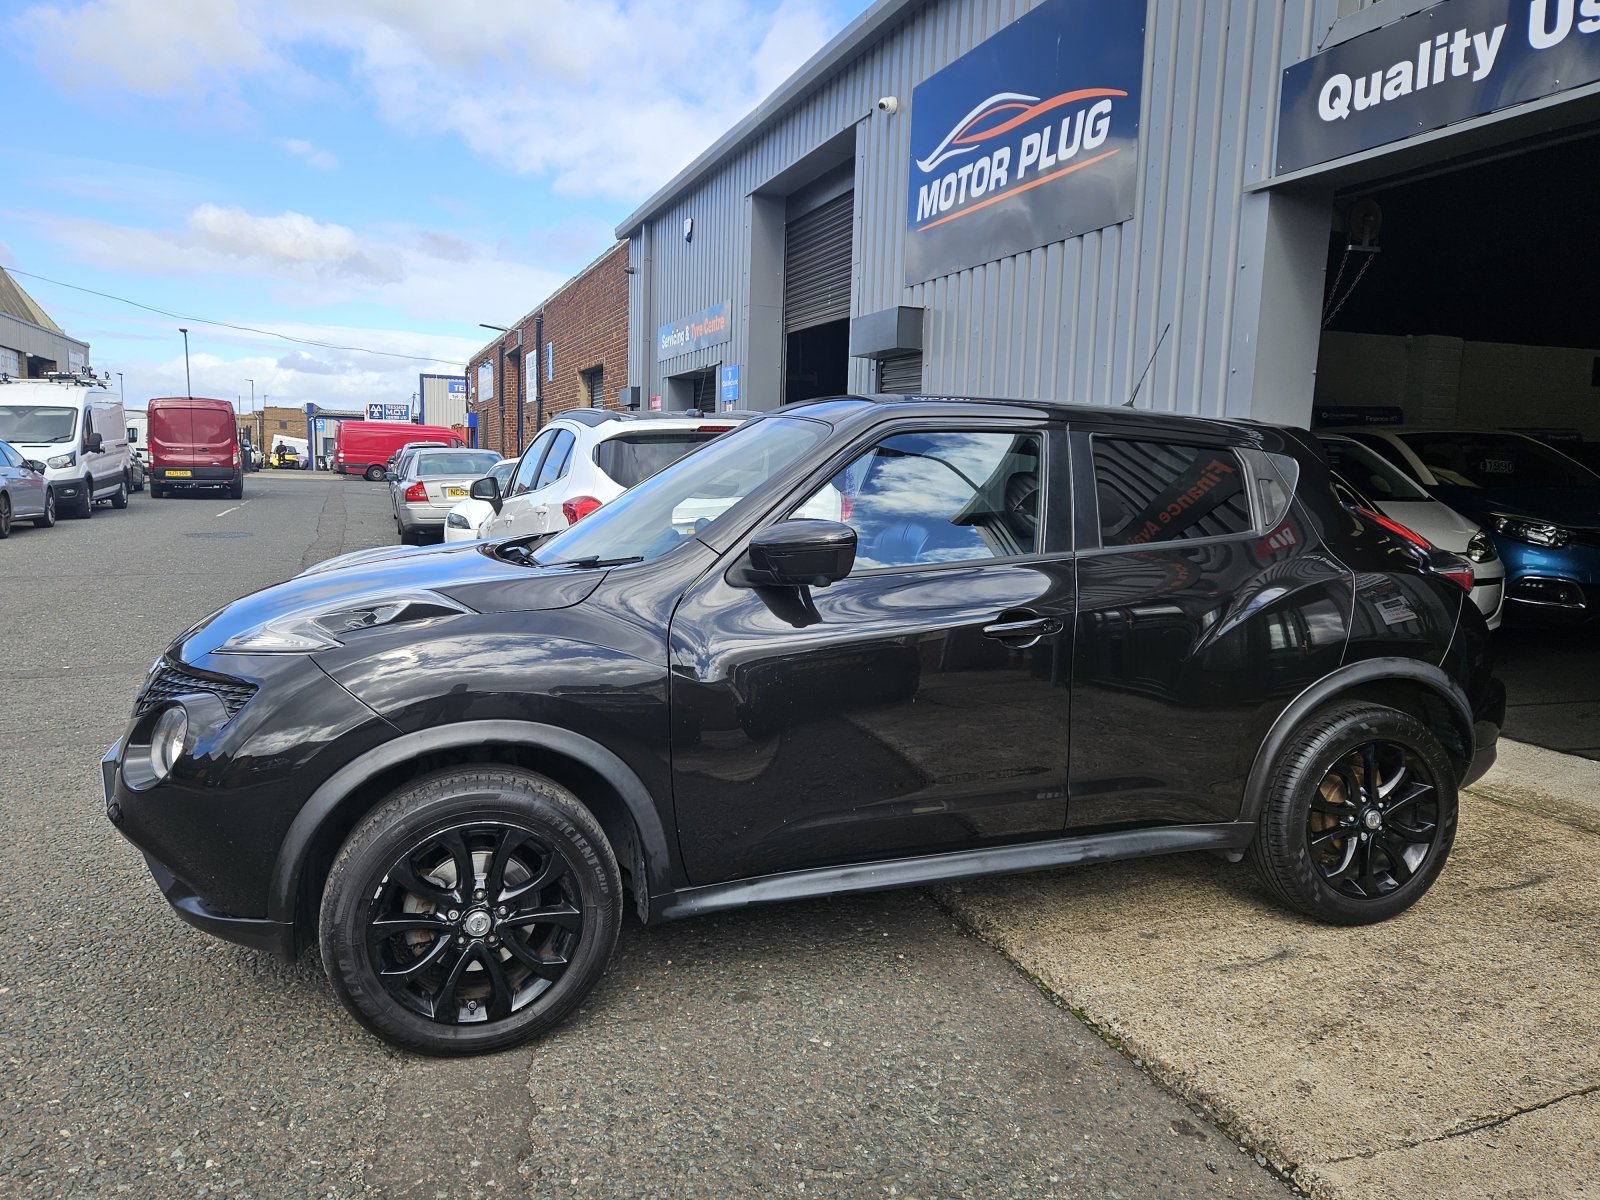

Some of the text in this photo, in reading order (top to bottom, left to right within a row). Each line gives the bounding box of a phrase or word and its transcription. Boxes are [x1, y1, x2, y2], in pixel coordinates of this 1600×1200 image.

[1318, 24, 1507, 121] Quality
[917, 99, 1112, 221] MOTOR PLUG
[662, 315, 725, 349] Servicing & Tyre Centre
